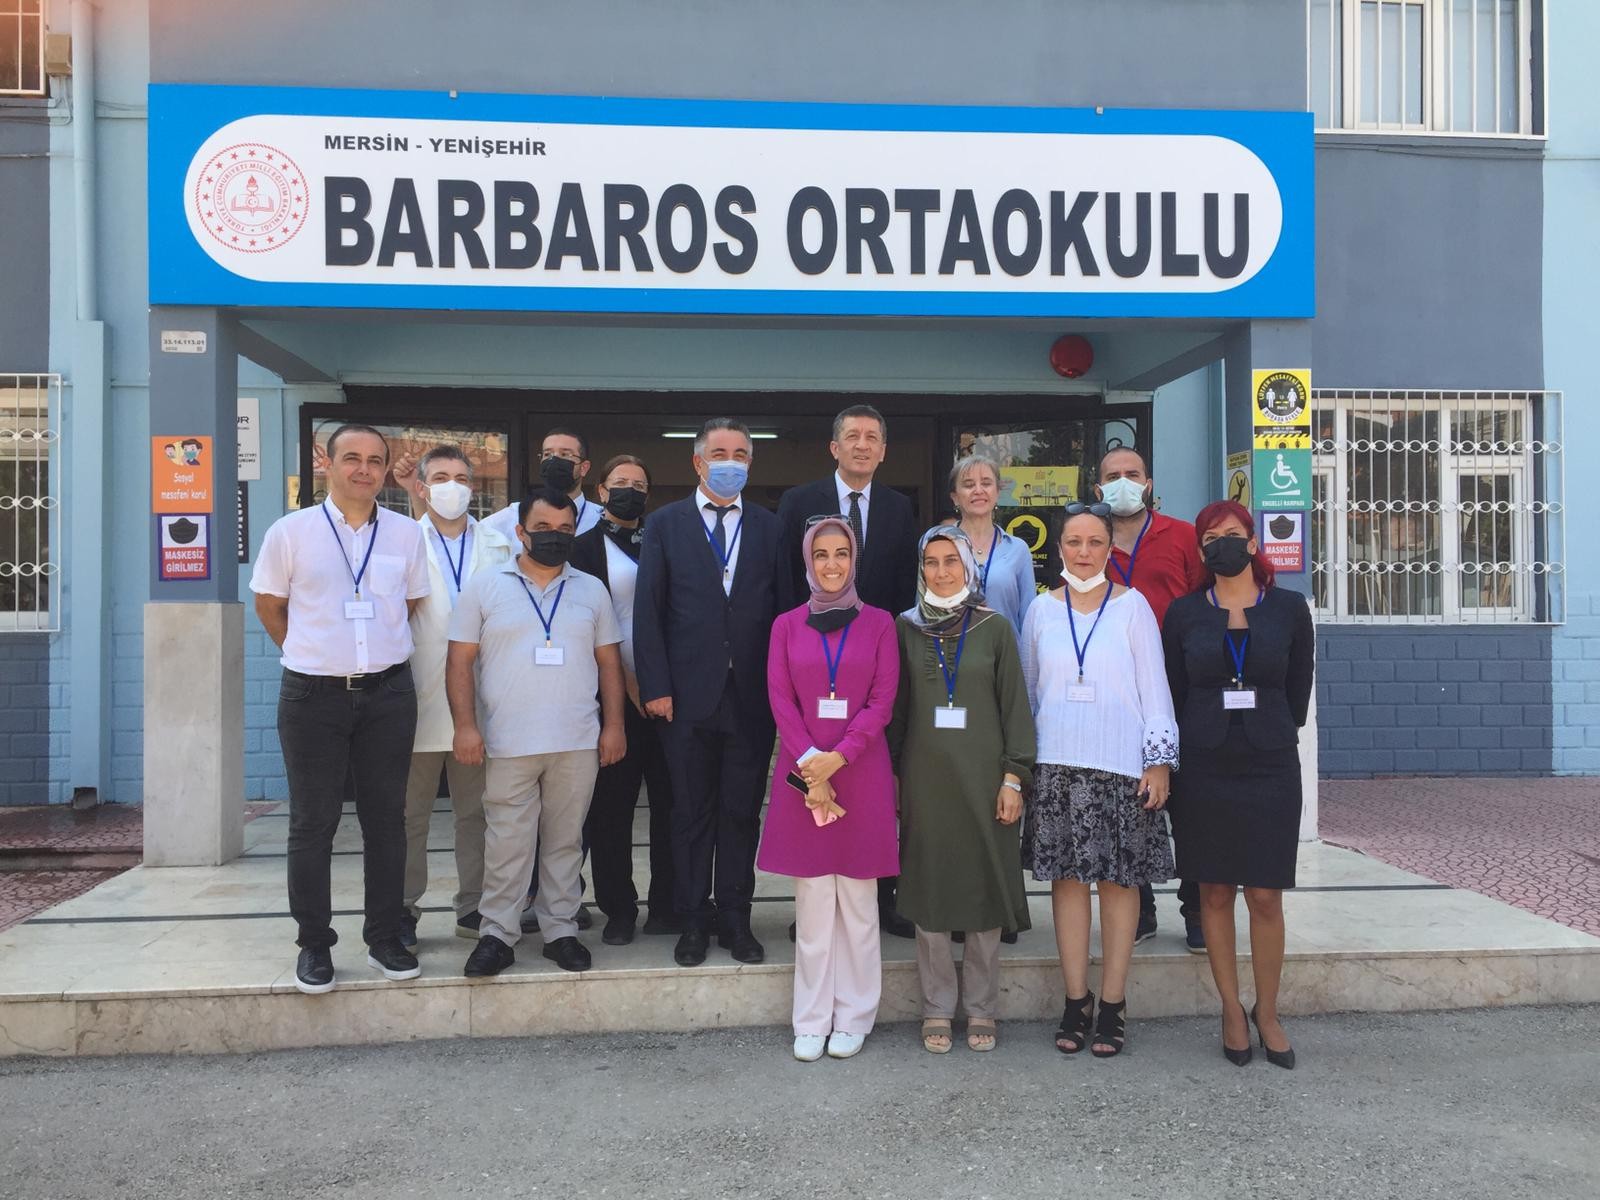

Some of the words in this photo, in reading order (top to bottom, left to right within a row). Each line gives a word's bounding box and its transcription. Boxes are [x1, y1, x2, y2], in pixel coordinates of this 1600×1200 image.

[324, 133, 409, 152] MERSİN
[429, 136, 547, 158] YENİŞEHİR
[323, 177, 759, 276] BARBAROS
[787, 186, 1250, 278] ORTAOKULU
[164, 549, 205, 560] MASKESİZ
[1265, 544, 1300, 554] MASKESİZ
[166, 561, 205, 573] GİRİLMEZ
